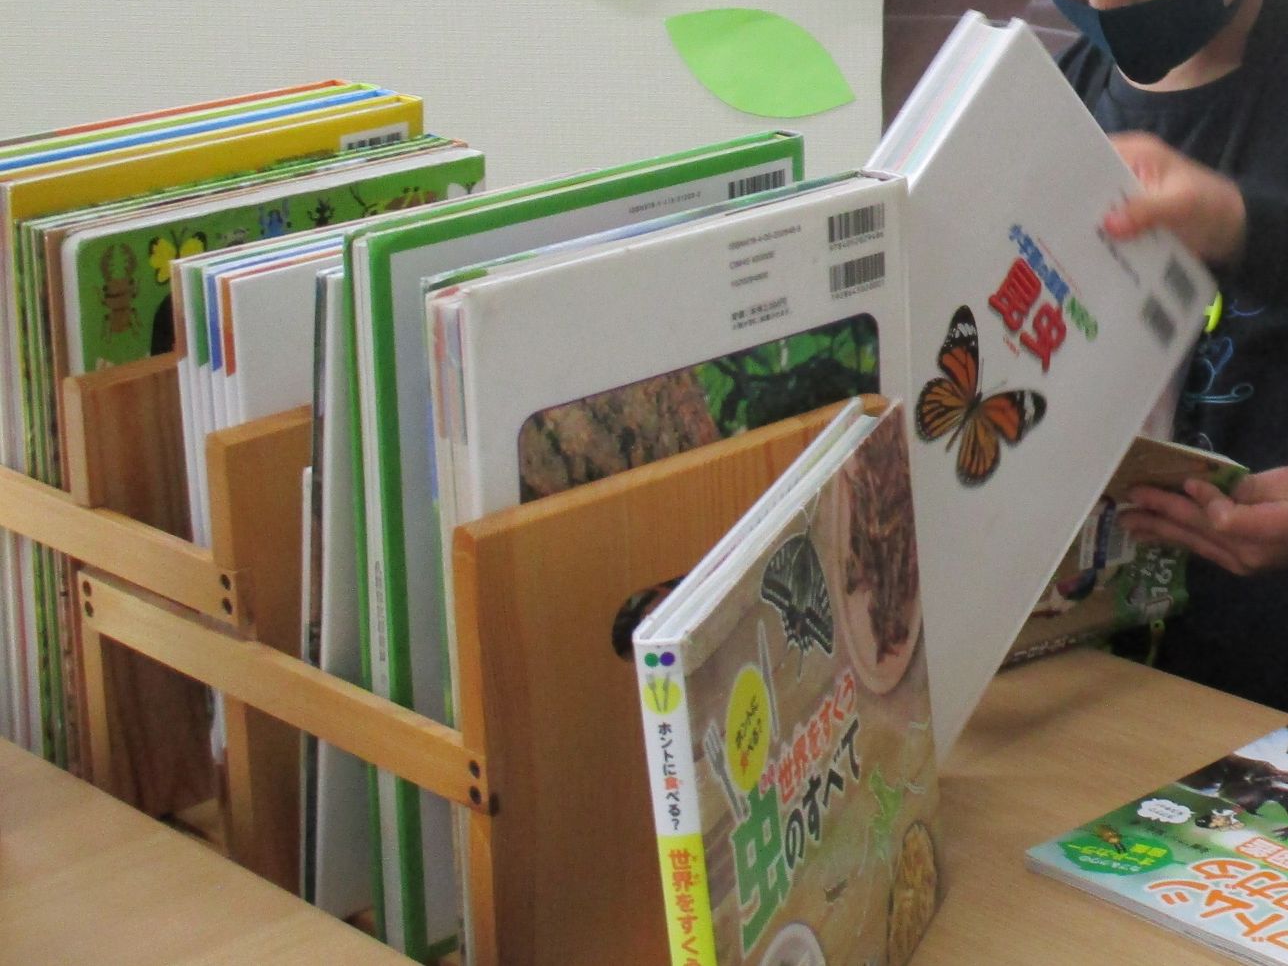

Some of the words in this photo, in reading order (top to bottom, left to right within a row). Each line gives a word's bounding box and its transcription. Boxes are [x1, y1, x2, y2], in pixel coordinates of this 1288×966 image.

[988, 258, 1067, 374] 昆虫
[658, 722, 682, 831] ホントに食べる?
[779, 672, 857, 805] 世界をすくう
